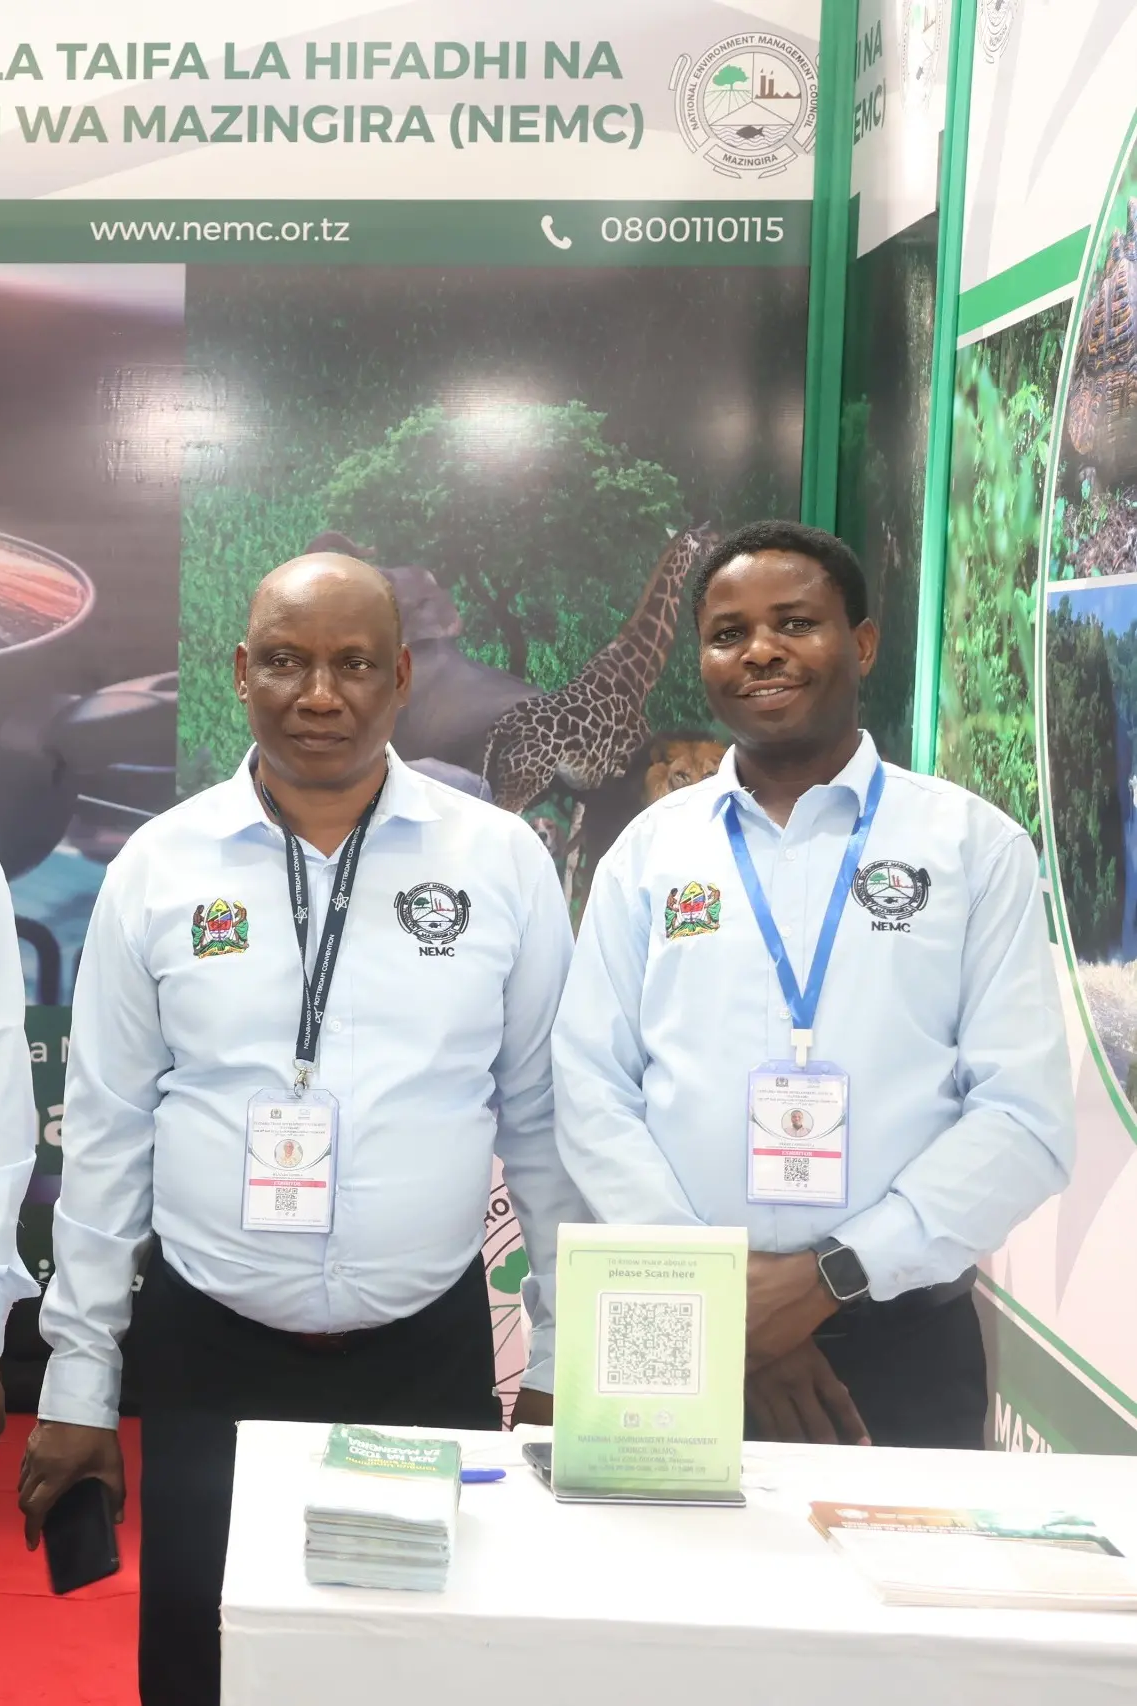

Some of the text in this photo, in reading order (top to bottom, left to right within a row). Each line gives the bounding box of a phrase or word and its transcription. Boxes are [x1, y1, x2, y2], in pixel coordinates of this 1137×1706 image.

[56, 41, 210, 81] TAIFA
[224, 41, 291, 81] LA
[305, 40, 527, 80] HIFADHI
[544, 40, 624, 80] NA
[686, 83, 700, 131] NATIONAL
[694, 35, 756, 80] ENVIRONMENT
[757, 35, 815, 81] MANAGEMENT
[803, 83, 819, 128] COUNCIL
[14, 105, 109, 145] WA
[123, 104, 436, 144] MAZINGIRA
[449, 102, 645, 150] (NEMC)
[722, 152, 778, 167] MAZINGIRA
[90, 218, 351, 242] www.nemc.or.tz
[600, 216, 784, 243] 0800110115
[289, 835, 302, 905] ROTTERDAM CONVENTION
[339, 825, 362, 892] ROTTERDAM CONVENTION
[871, 920, 911, 933] NEMC
[418, 946, 456, 957] NEMC
[313, 934, 335, 1006] ROTTERDAM CONVENTION
[303, 1009, 312, 1050] CONVENTION
[607, 1257, 697, 1268] To know more about us
[608, 1269, 696, 1279] please Scan here
[347, 1435, 419, 1457] MAZINGIRA
[667, 1437, 718, 1446] MANAGEMENT
[348, 1445, 438, 1464] ADA NA TOZO
